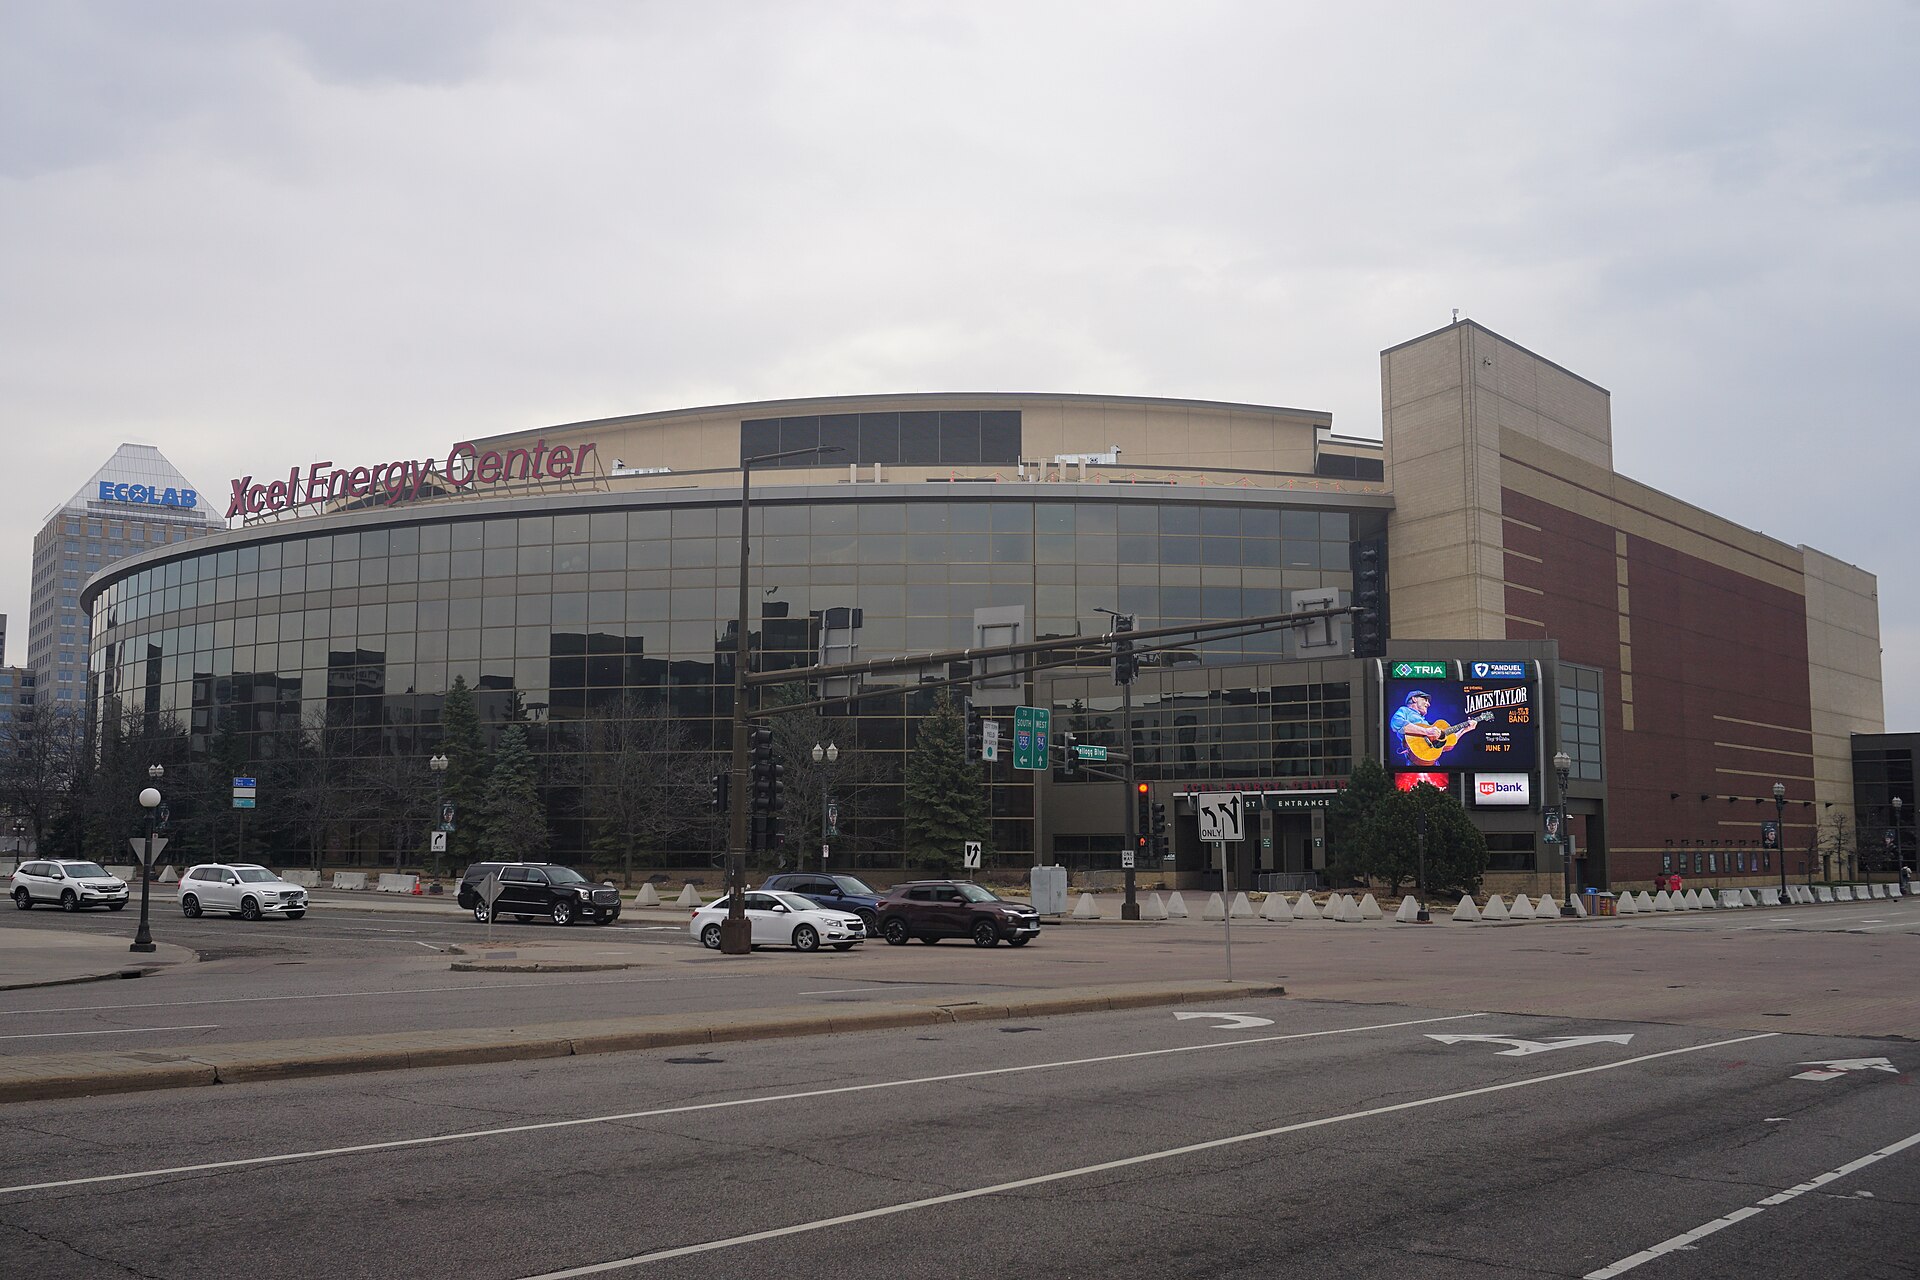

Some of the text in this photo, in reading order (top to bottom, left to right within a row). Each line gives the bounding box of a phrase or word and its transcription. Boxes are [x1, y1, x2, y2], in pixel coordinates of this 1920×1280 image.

[225, 439, 597, 518] Xcel Energy Center
[100, 481, 197, 508] ECOLAB
[1414, 666, 1442, 674] TRIA
[1465, 687, 1527, 714] JAMES TAYLOR
[1017, 719, 1031, 728] SOUTH
[1509, 715, 1529, 723] BAND
[1036, 720, 1047, 729] WEST
[1019, 736, 1028, 746] 35E
[1037, 737, 1044, 747] 94
[1094, 748, 1105, 756] Blvd
[1485, 744, 1510, 752] JUNE 17
[1292, 779, 1347, 790] CENTER
[1496, 782, 1522, 792] bank
[1202, 829, 1221, 837] ONLY
